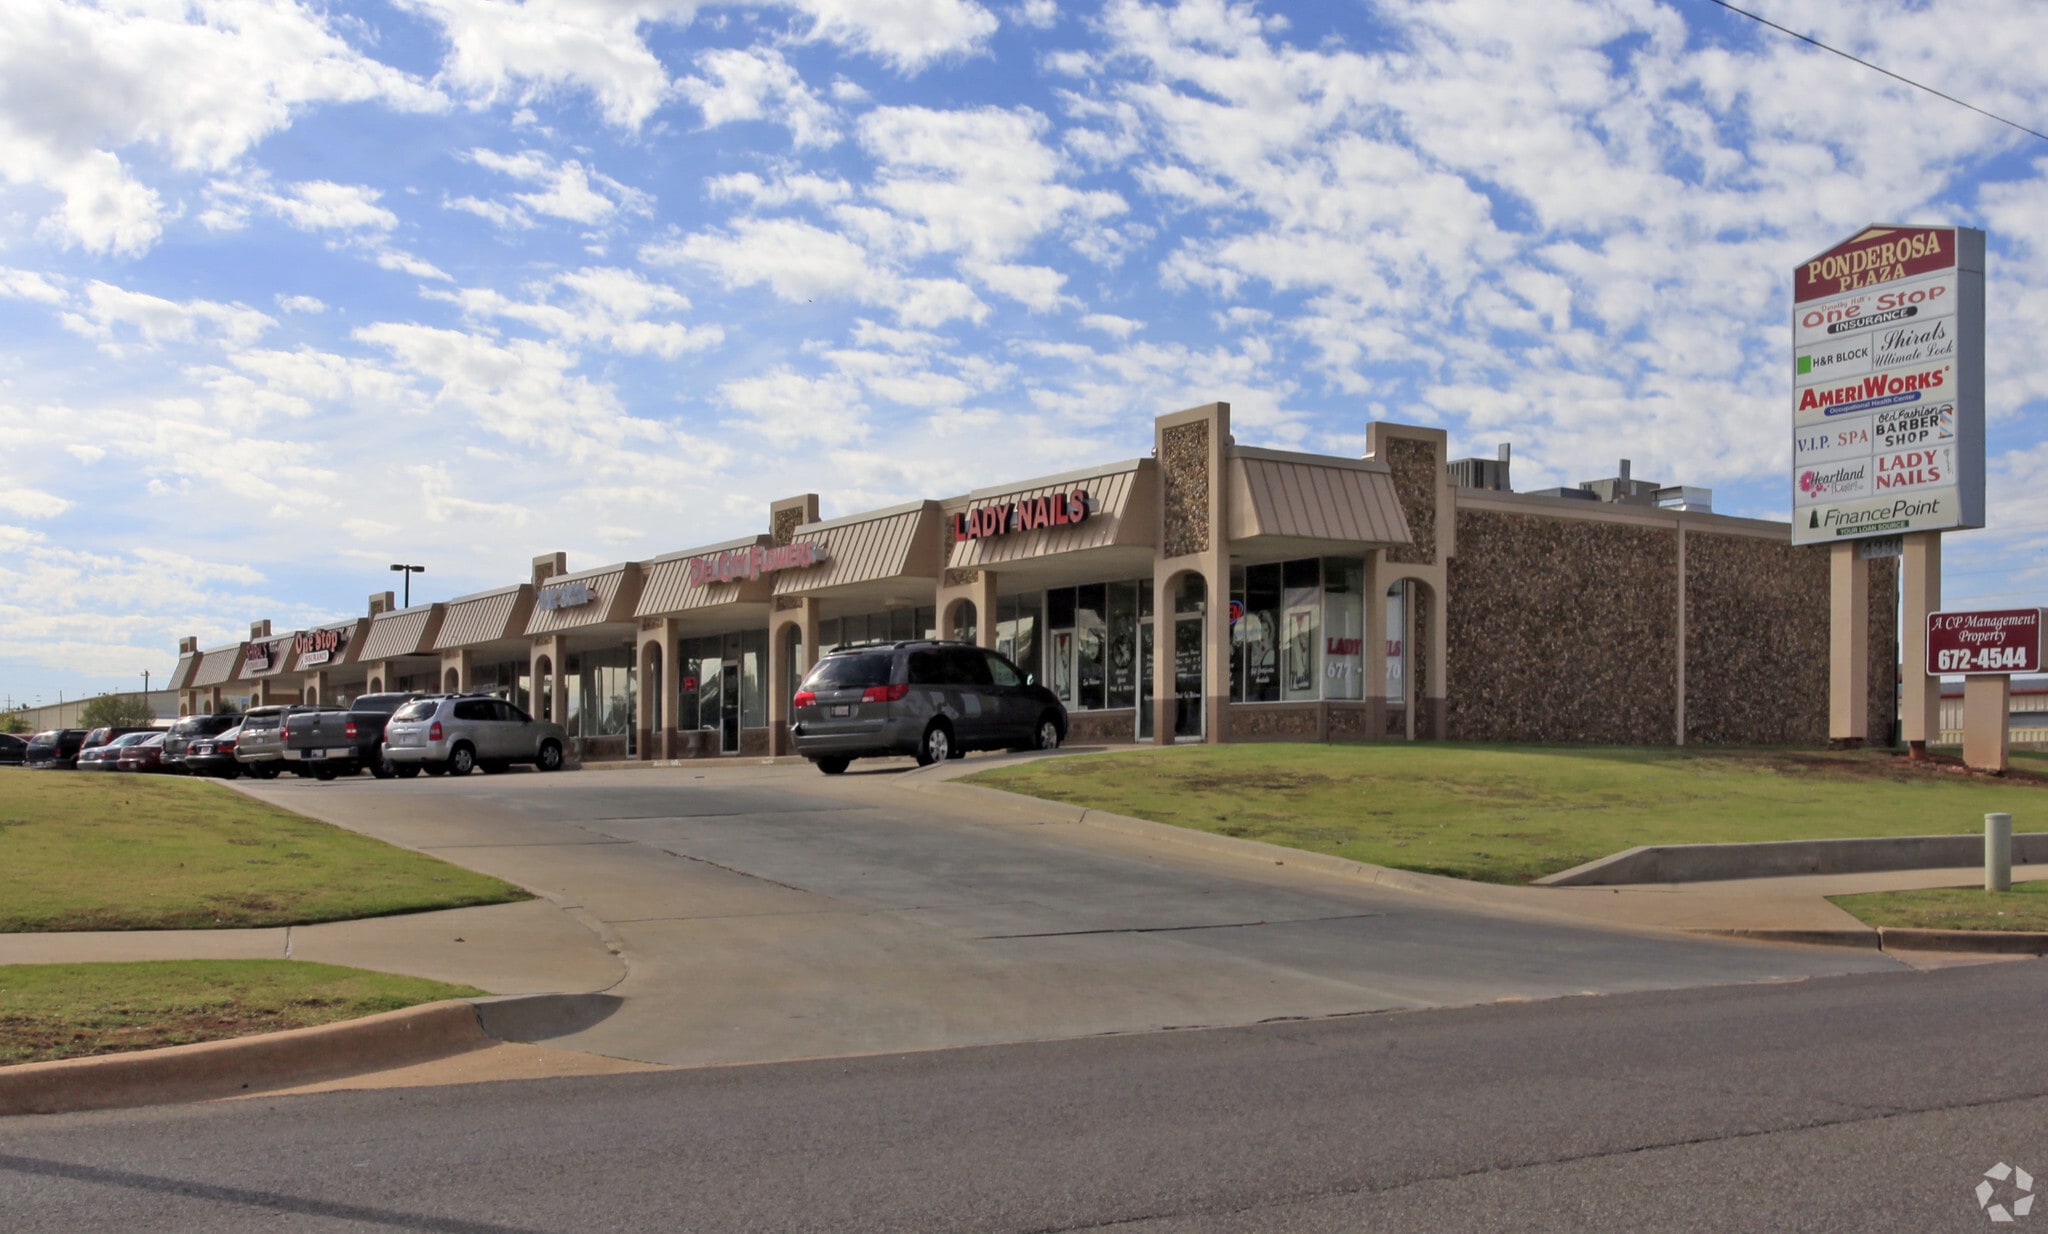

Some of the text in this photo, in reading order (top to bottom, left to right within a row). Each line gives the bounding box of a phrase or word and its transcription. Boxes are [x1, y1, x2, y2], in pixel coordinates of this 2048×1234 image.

[1808, 231, 1941, 284] PONDEROSA
[1839, 265, 1906, 292] PLAZA
[1803, 286, 1946, 328] One Stop
[1835, 309, 1908, 332] INSURANCE
[1813, 347, 1869, 368] H&R BLOCK
[1873, 340, 1953, 367] Ultimate Look
[1830, 394, 1915, 414] Occupational Health Center
[1876, 415, 1938, 436] BARBER
[1879, 411, 1897, 423] Old
[1798, 429, 1868, 452] V.I.P. SPA
[1885, 430, 1929, 447] SHOP
[1879, 450, 1938, 472] LADY
[1811, 465, 1864, 484] Heartland
[1876, 467, 1940, 489] NAILS
[955, 489, 1088, 542] LADY NAILS
[1840, 521, 1906, 535] YOUR LOAN SOURCE
[1931, 614, 2036, 631] A CP Management
[295, 632, 313, 654] One
[315, 629, 338, 653] Stop
[1327, 637, 1361, 656] LADY
[1959, 629, 2006, 646] Property
[1938, 646, 2027, 670] 672-4544
